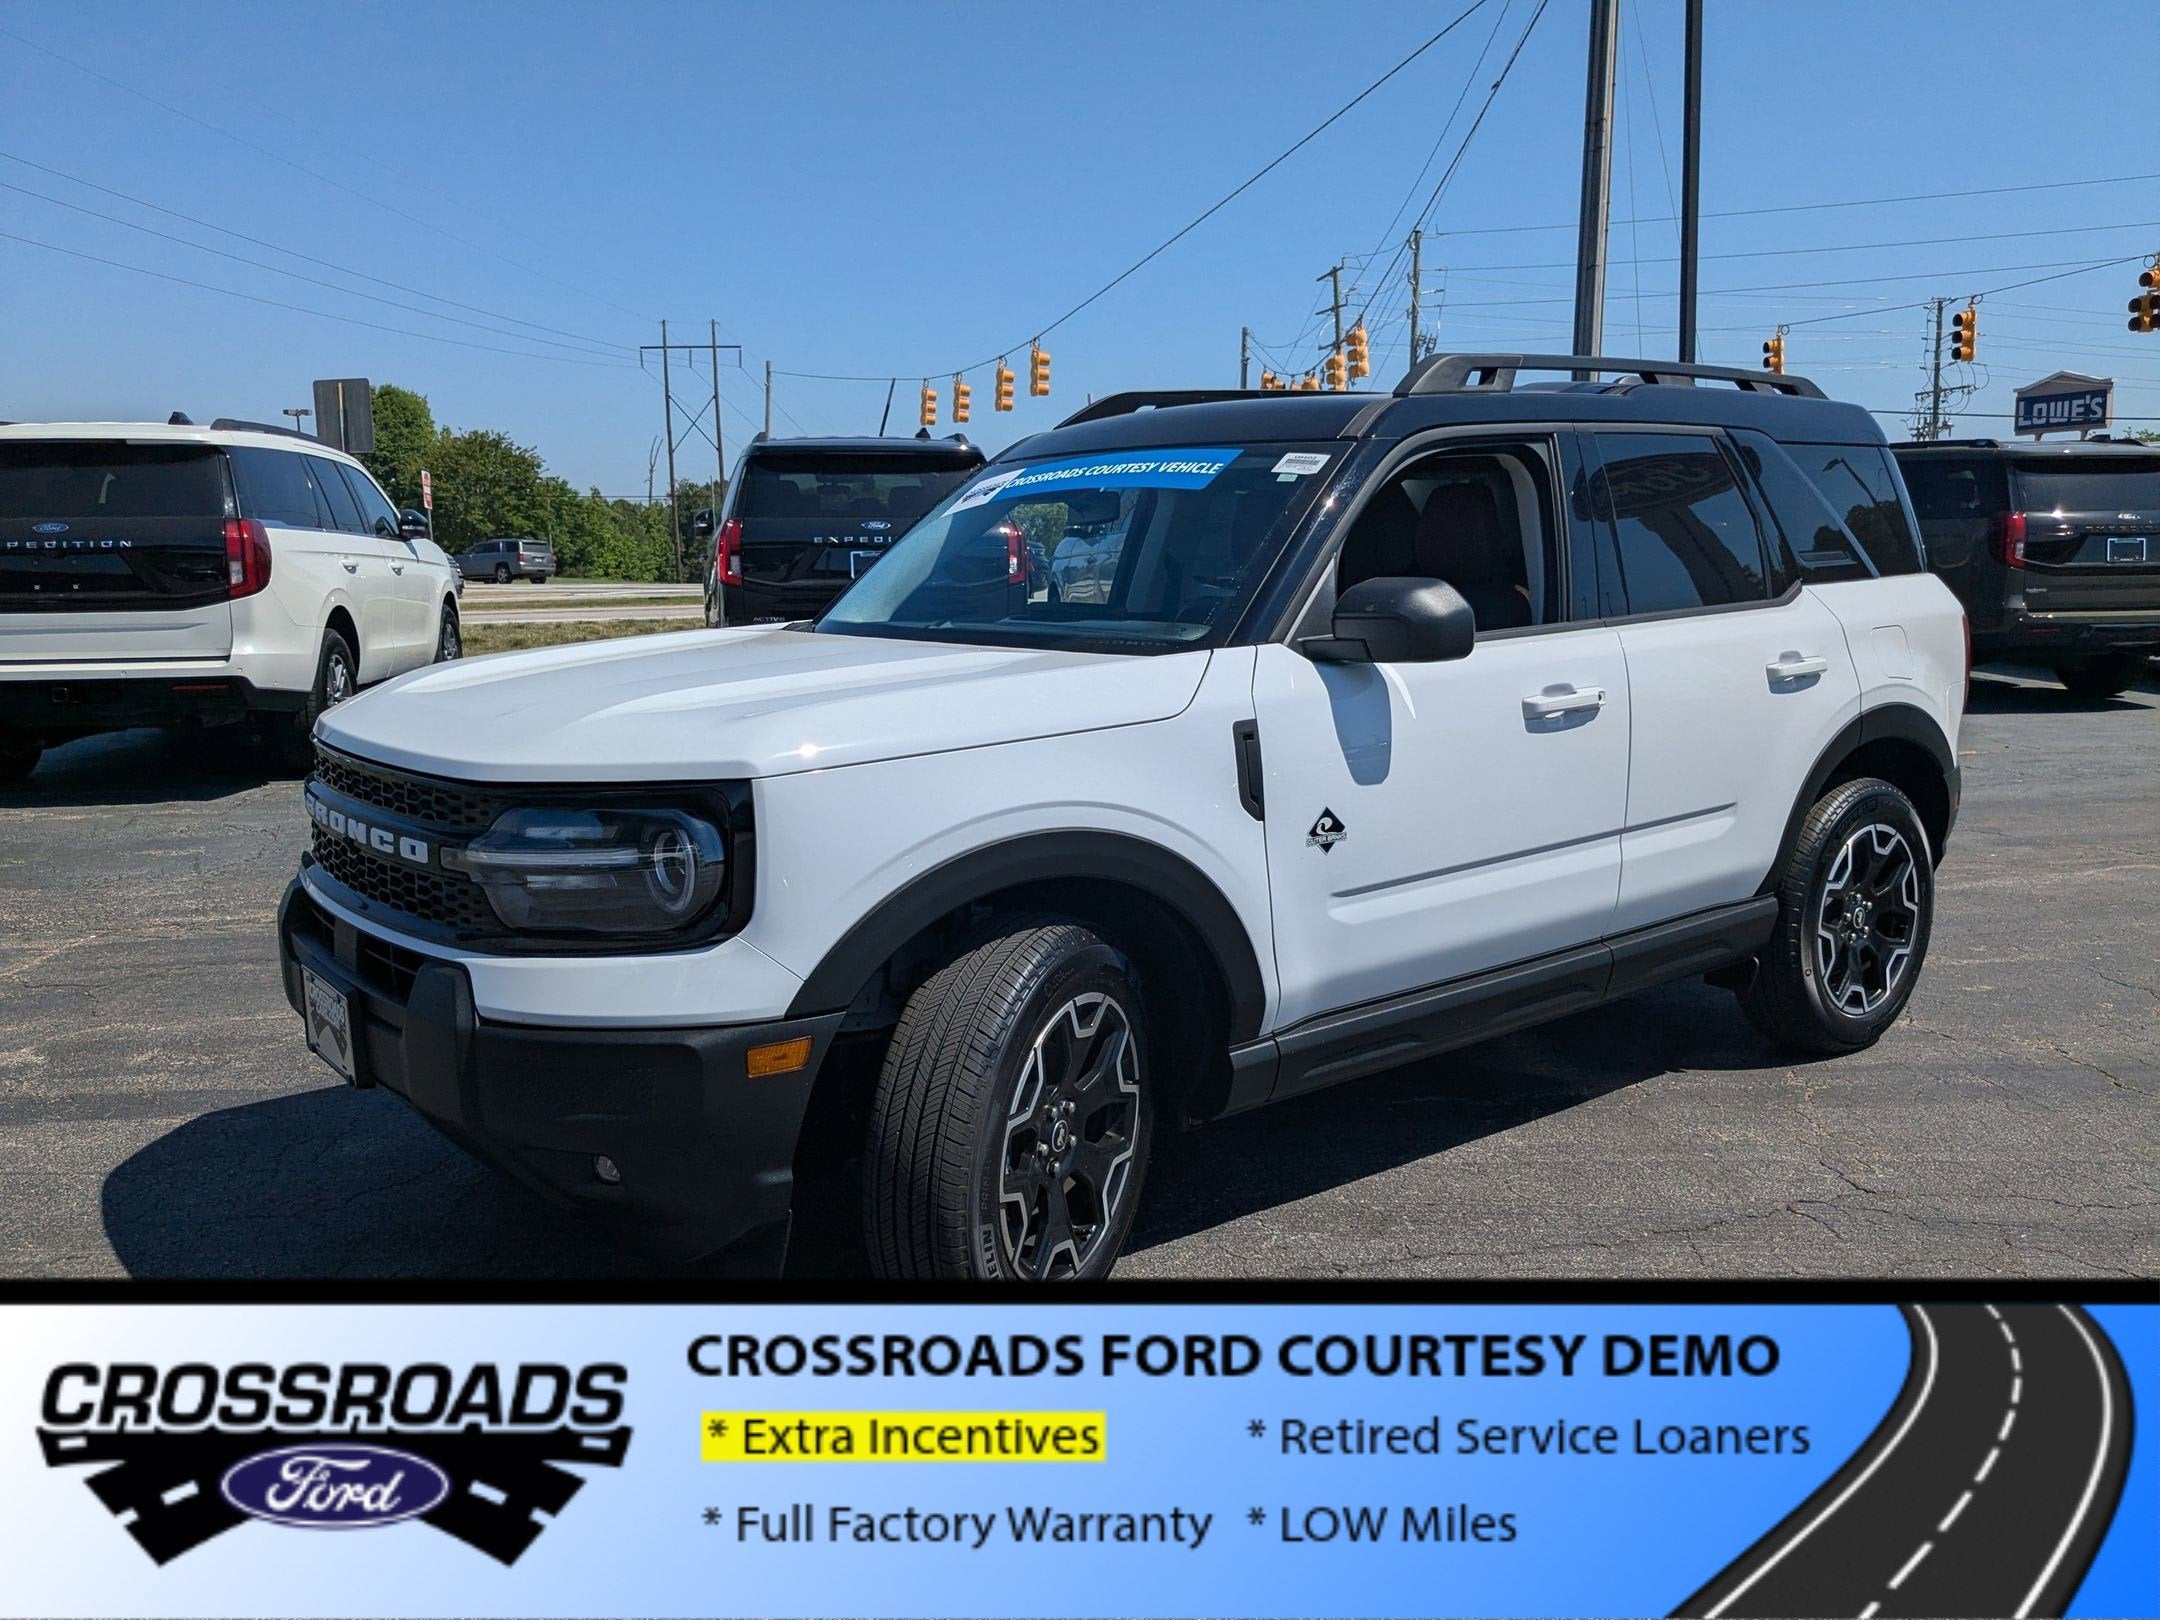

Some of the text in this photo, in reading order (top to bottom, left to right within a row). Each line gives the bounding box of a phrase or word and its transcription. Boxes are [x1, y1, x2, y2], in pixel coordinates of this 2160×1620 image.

[2018, 395, 2103, 426] LOWE'S
[1005, 462, 1224, 489] CROSSROADS COURTESY VEHICLE
[306, 793, 428, 864] BRONCO
